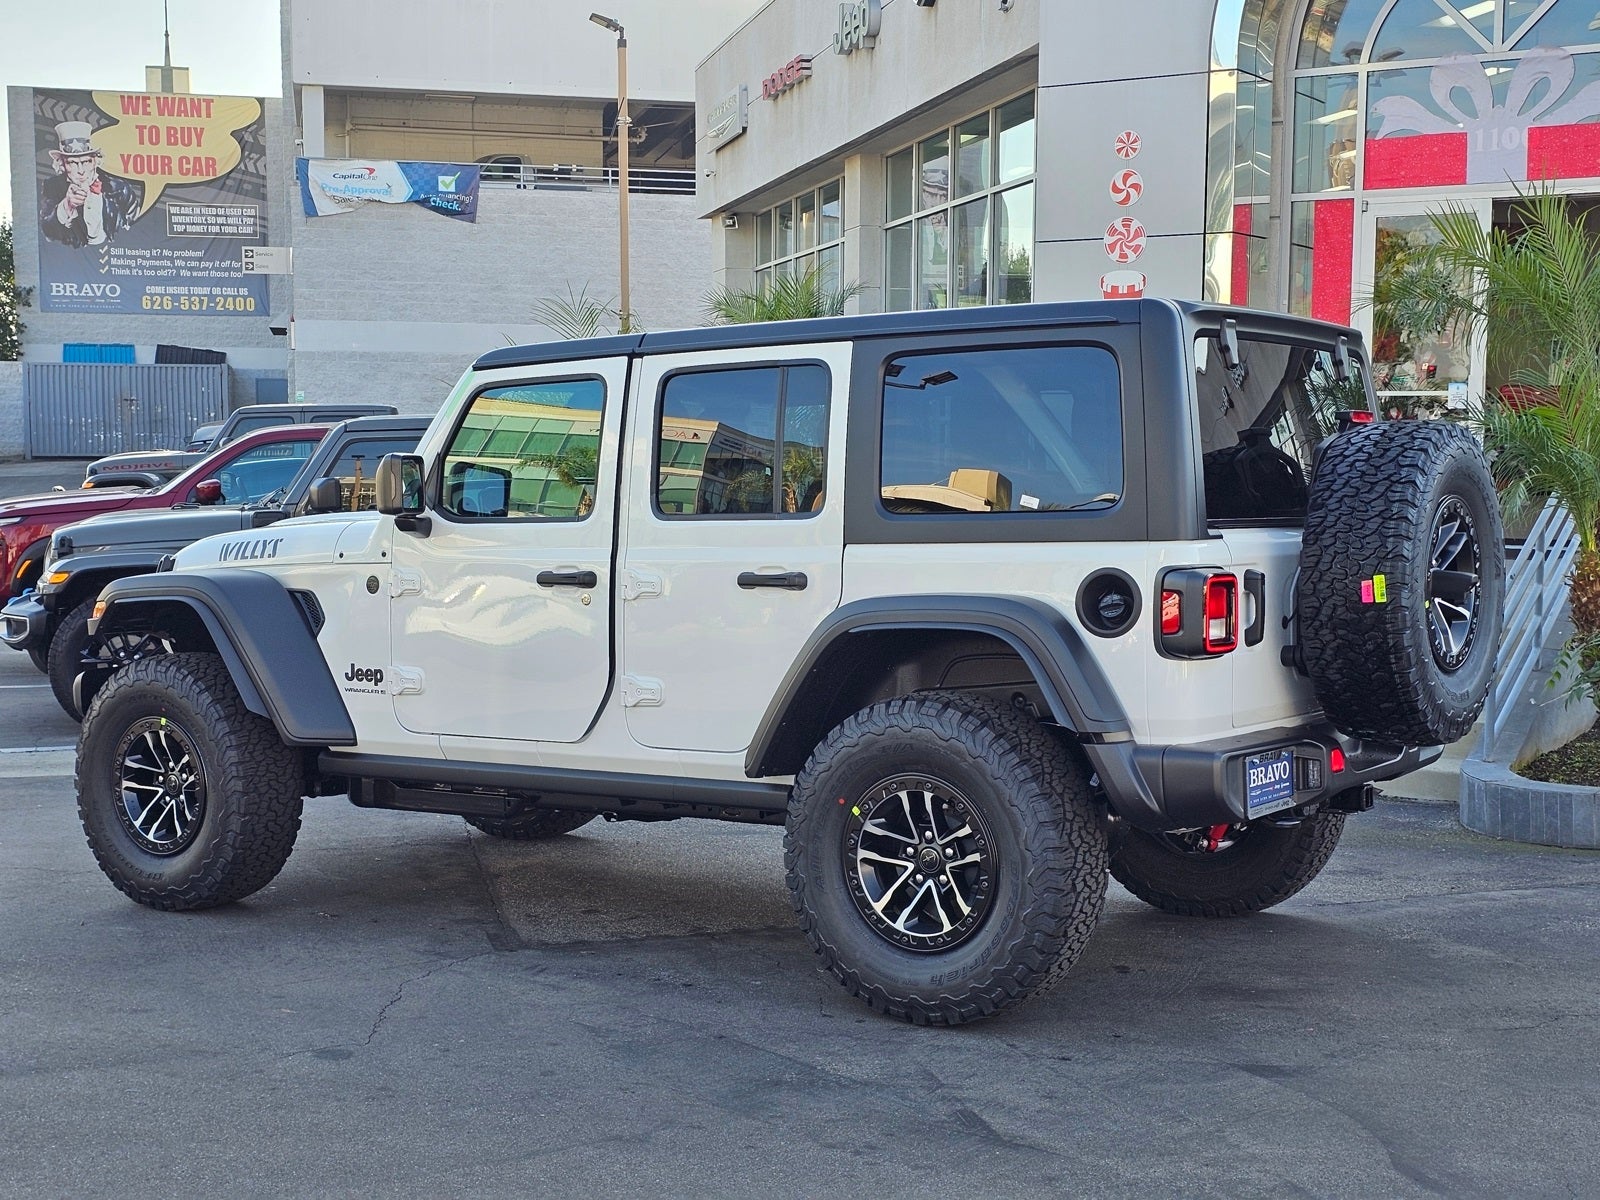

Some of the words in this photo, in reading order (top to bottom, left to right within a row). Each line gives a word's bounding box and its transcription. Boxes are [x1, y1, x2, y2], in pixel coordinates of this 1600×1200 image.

[833, 1, 872, 54] Jeep
[762, 54, 812, 100] DODGE
[120, 95, 151, 116] WE
[156, 95, 214, 118] WANT
[135, 124, 160, 146] TO
[166, 126, 205, 148] BUY
[120, 153, 173, 176] YOUR
[177, 155, 217, 177] CAR
[170, 206, 180, 214] WE
[226, 208, 242, 216] USED
[242, 208, 256, 216] CAR
[430, 197, 462, 211] Check.
[172, 216, 206, 224] INVENTORY,
[207, 216, 216, 224] SO
[173, 224, 185, 232] TOP
[208, 225, 220, 233] FOR
[238, 226, 253, 234] CAR!
[126, 248, 150, 257] leasing
[173, 249, 204, 258] problem!
[110, 258, 136, 267] Making
[137, 258, 173, 267] Payments,
[144, 268, 155, 276] too
[156, 268, 176, 276] old??
[50, 282, 120, 297] BRAVO
[146, 286, 166, 294] COME
[166, 286, 189, 294] INSIDE
[190, 287, 211, 295] TODAY
[211, 287, 221, 295] OR
[142, 295, 255, 312] 626-537-2400
[102, 462, 174, 471] MOJAVE
[219, 538, 284, 562] WILLYS
[344, 663, 384, 686] Jeep
[344, 686, 380, 694] WRANGLER
[1250, 761, 1290, 788] BRAVO
